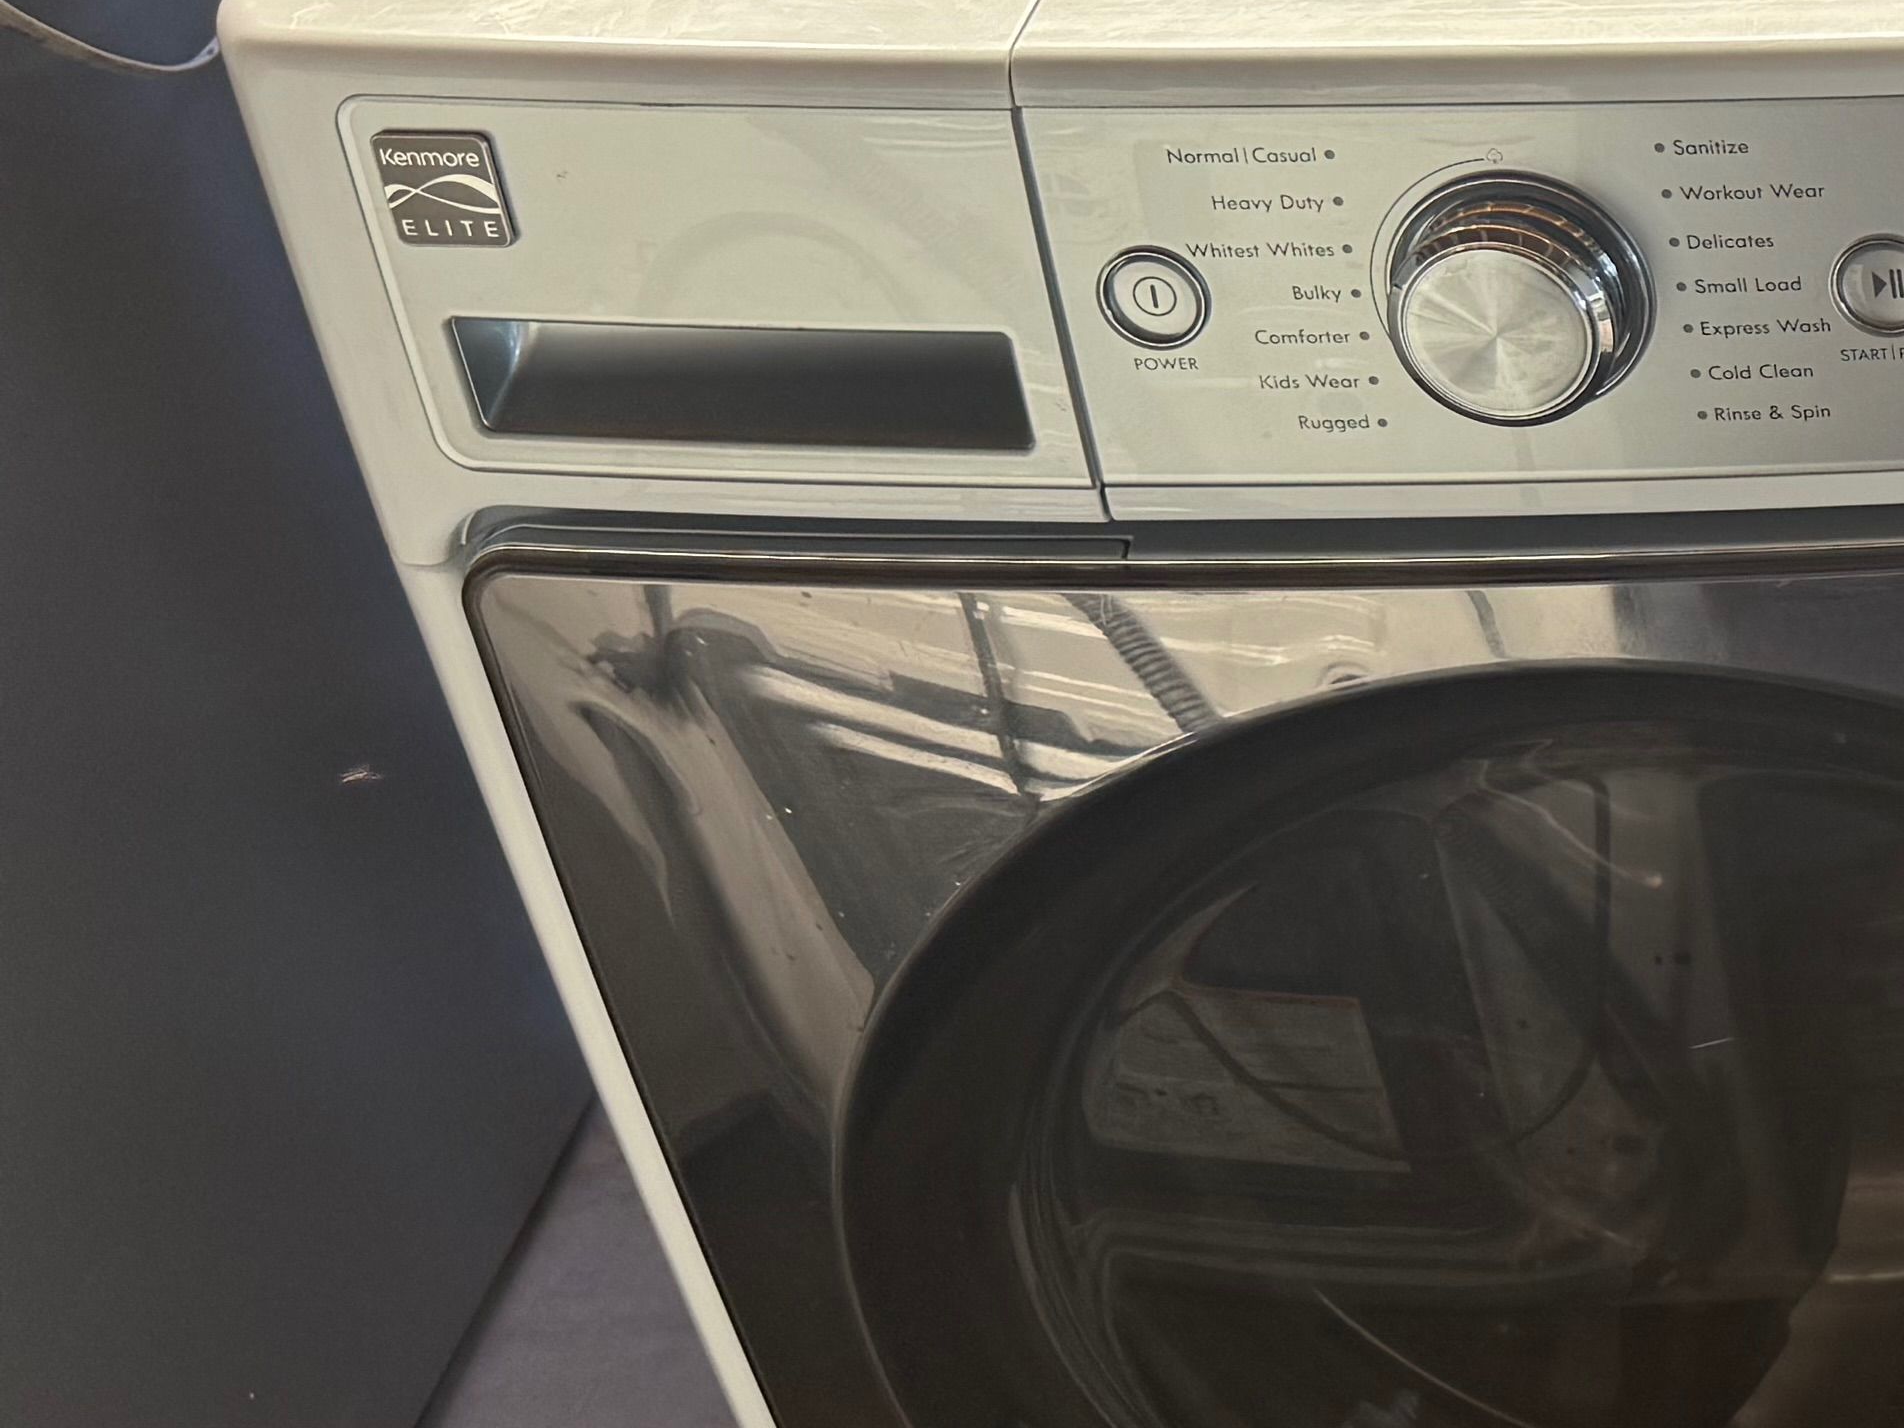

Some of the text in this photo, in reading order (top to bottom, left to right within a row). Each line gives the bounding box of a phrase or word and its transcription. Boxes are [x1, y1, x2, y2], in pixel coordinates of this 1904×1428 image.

[1672, 139, 1750, 156] Sanitize
[379, 147, 480, 170] Kenmore
[1680, 183, 1825, 201] Workout Wear
[1212, 193, 1324, 213] Heavy Duty
[401, 218, 500, 238] ELITE
[1185, 242, 1335, 259] Whitest Whites
[1686, 234, 1775, 251] Delicates
[1695, 277, 1802, 294] Small Load
[1292, 285, 1342, 304] Bulky
[1255, 328, 1351, 345] Comforter
[1700, 319, 1831, 339] Express Wash
[1134, 357, 1199, 372] POWER
[1708, 364, 1814, 381] Cold Clean
[1259, 374, 1360, 390] Kids Wear
[1715, 404, 1831, 422] Rinse & Spin
[1298, 414, 1370, 434] Rugged
